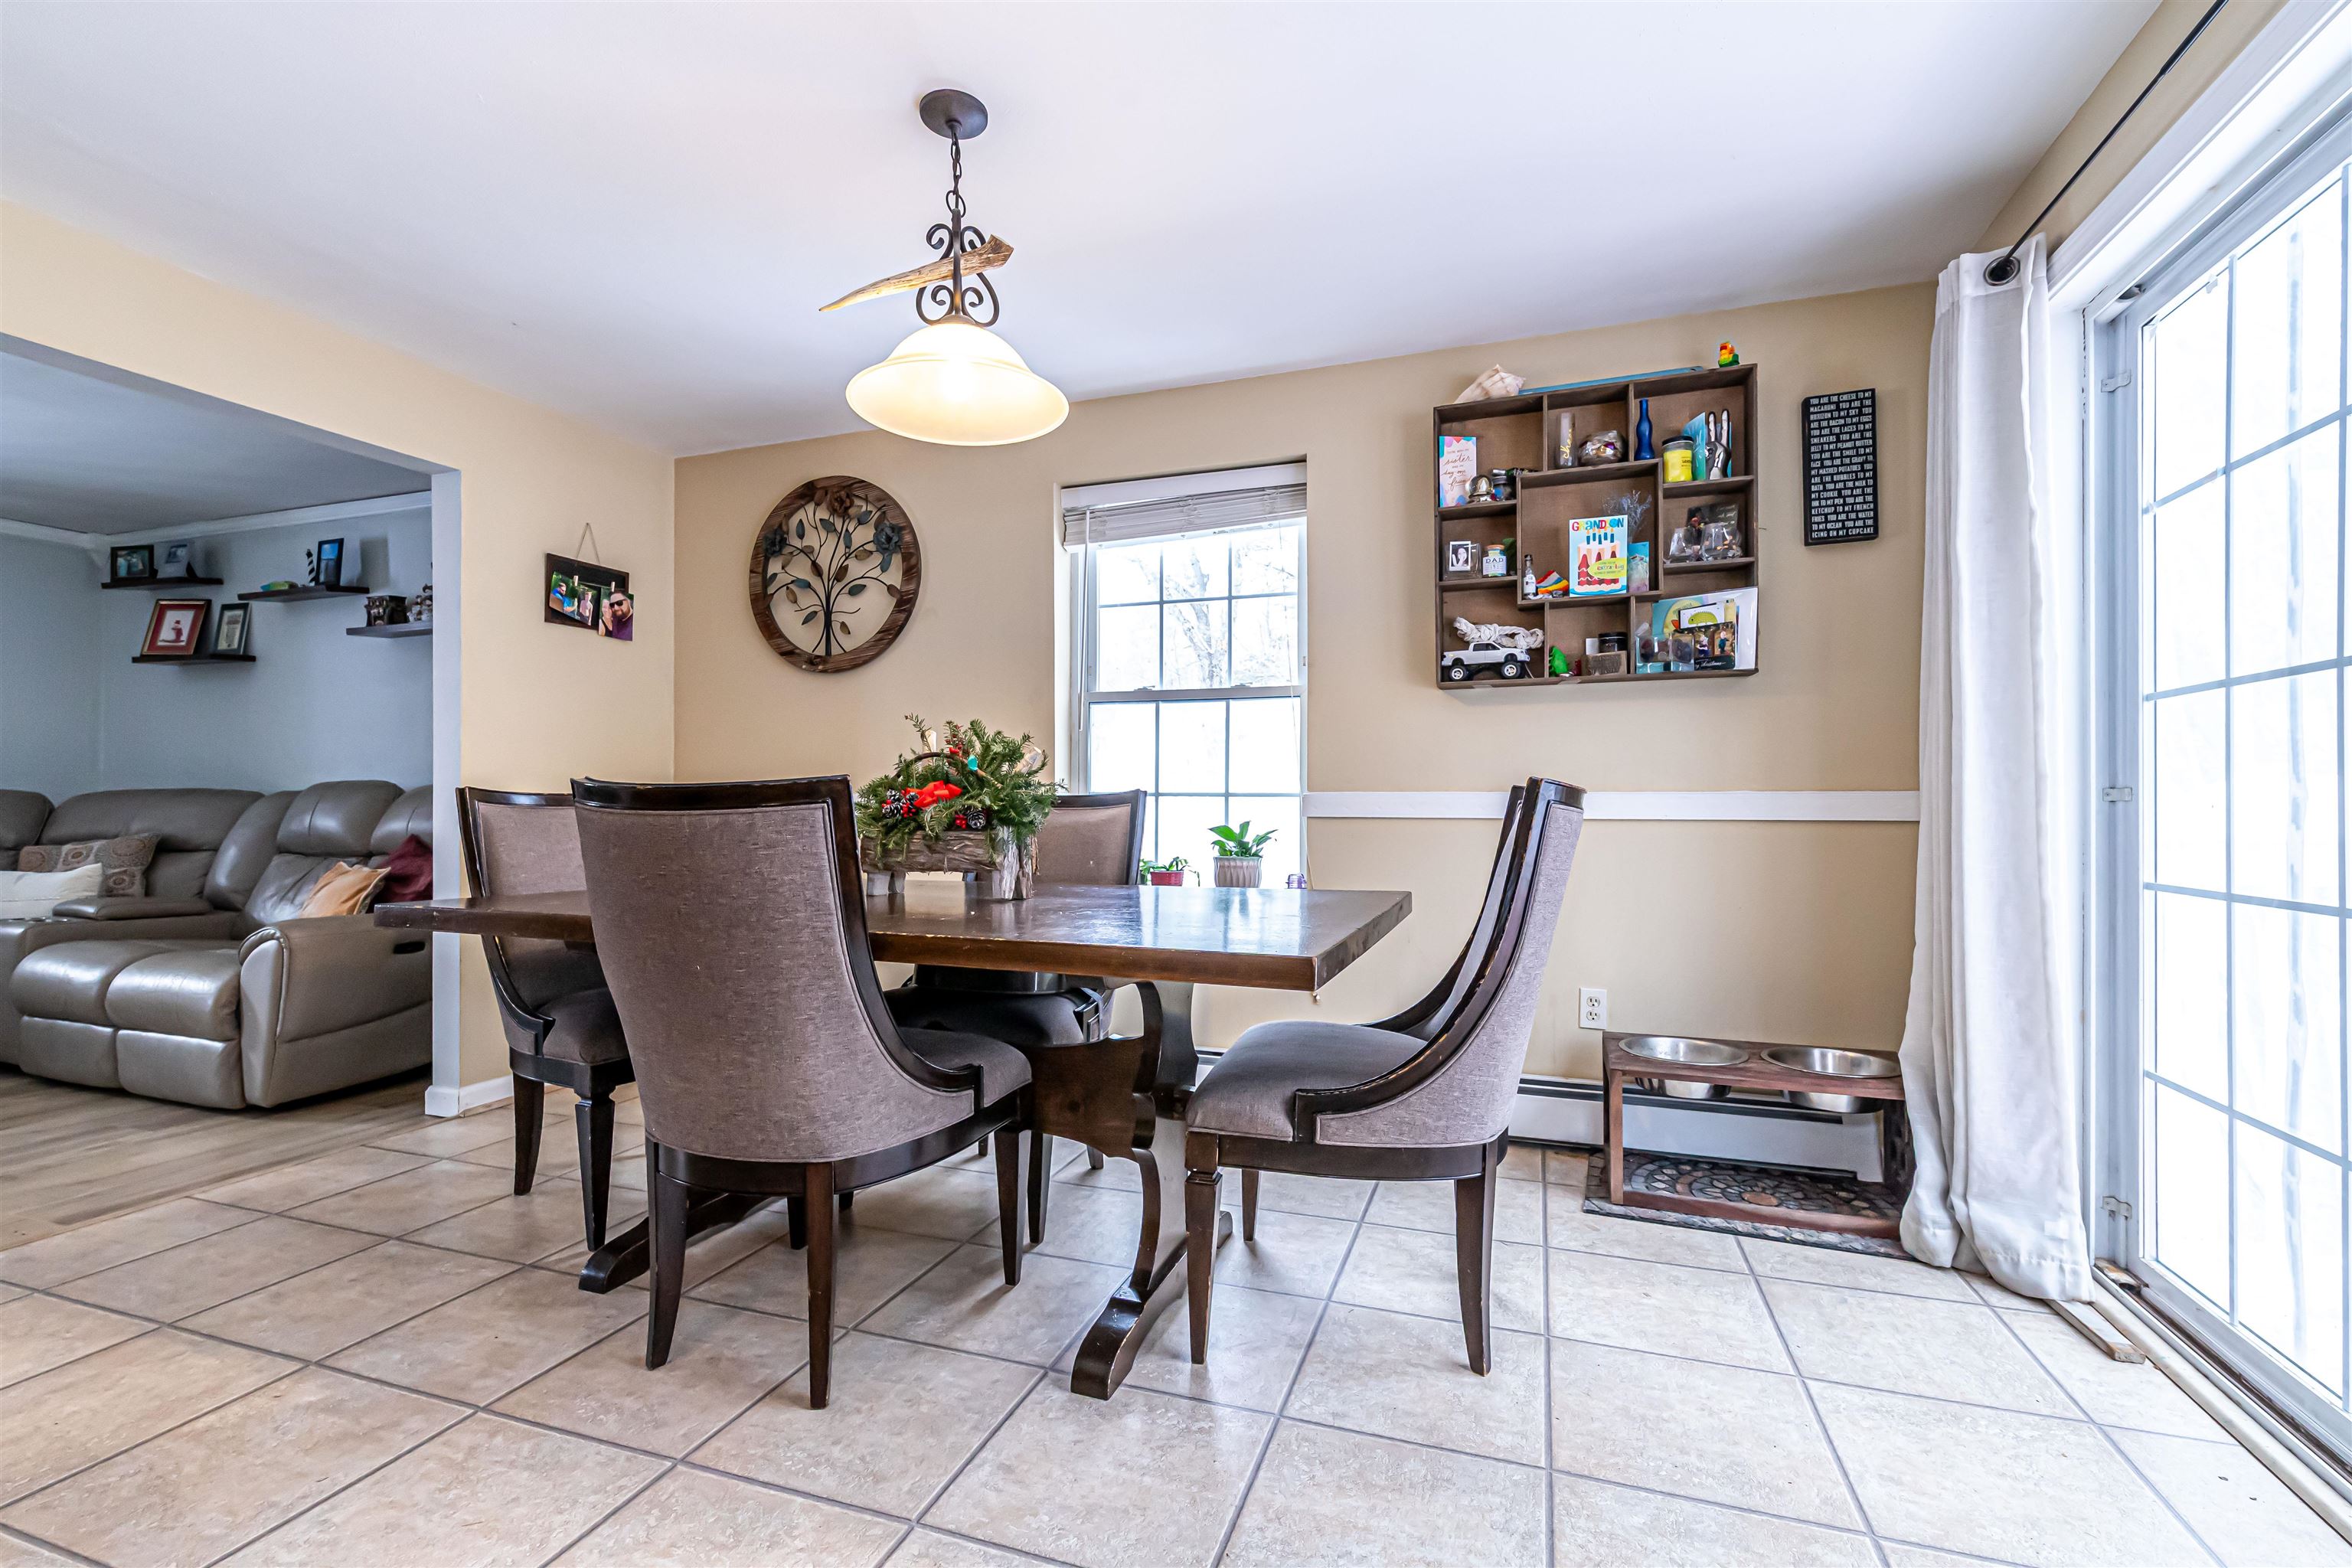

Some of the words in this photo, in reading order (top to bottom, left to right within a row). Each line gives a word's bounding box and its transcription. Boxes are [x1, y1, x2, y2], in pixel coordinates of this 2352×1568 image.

[1810, 404, 1836, 412] MACARONI
[1811, 435, 1836, 444] SNEAKERS
[1444, 453, 1473, 466] sister
